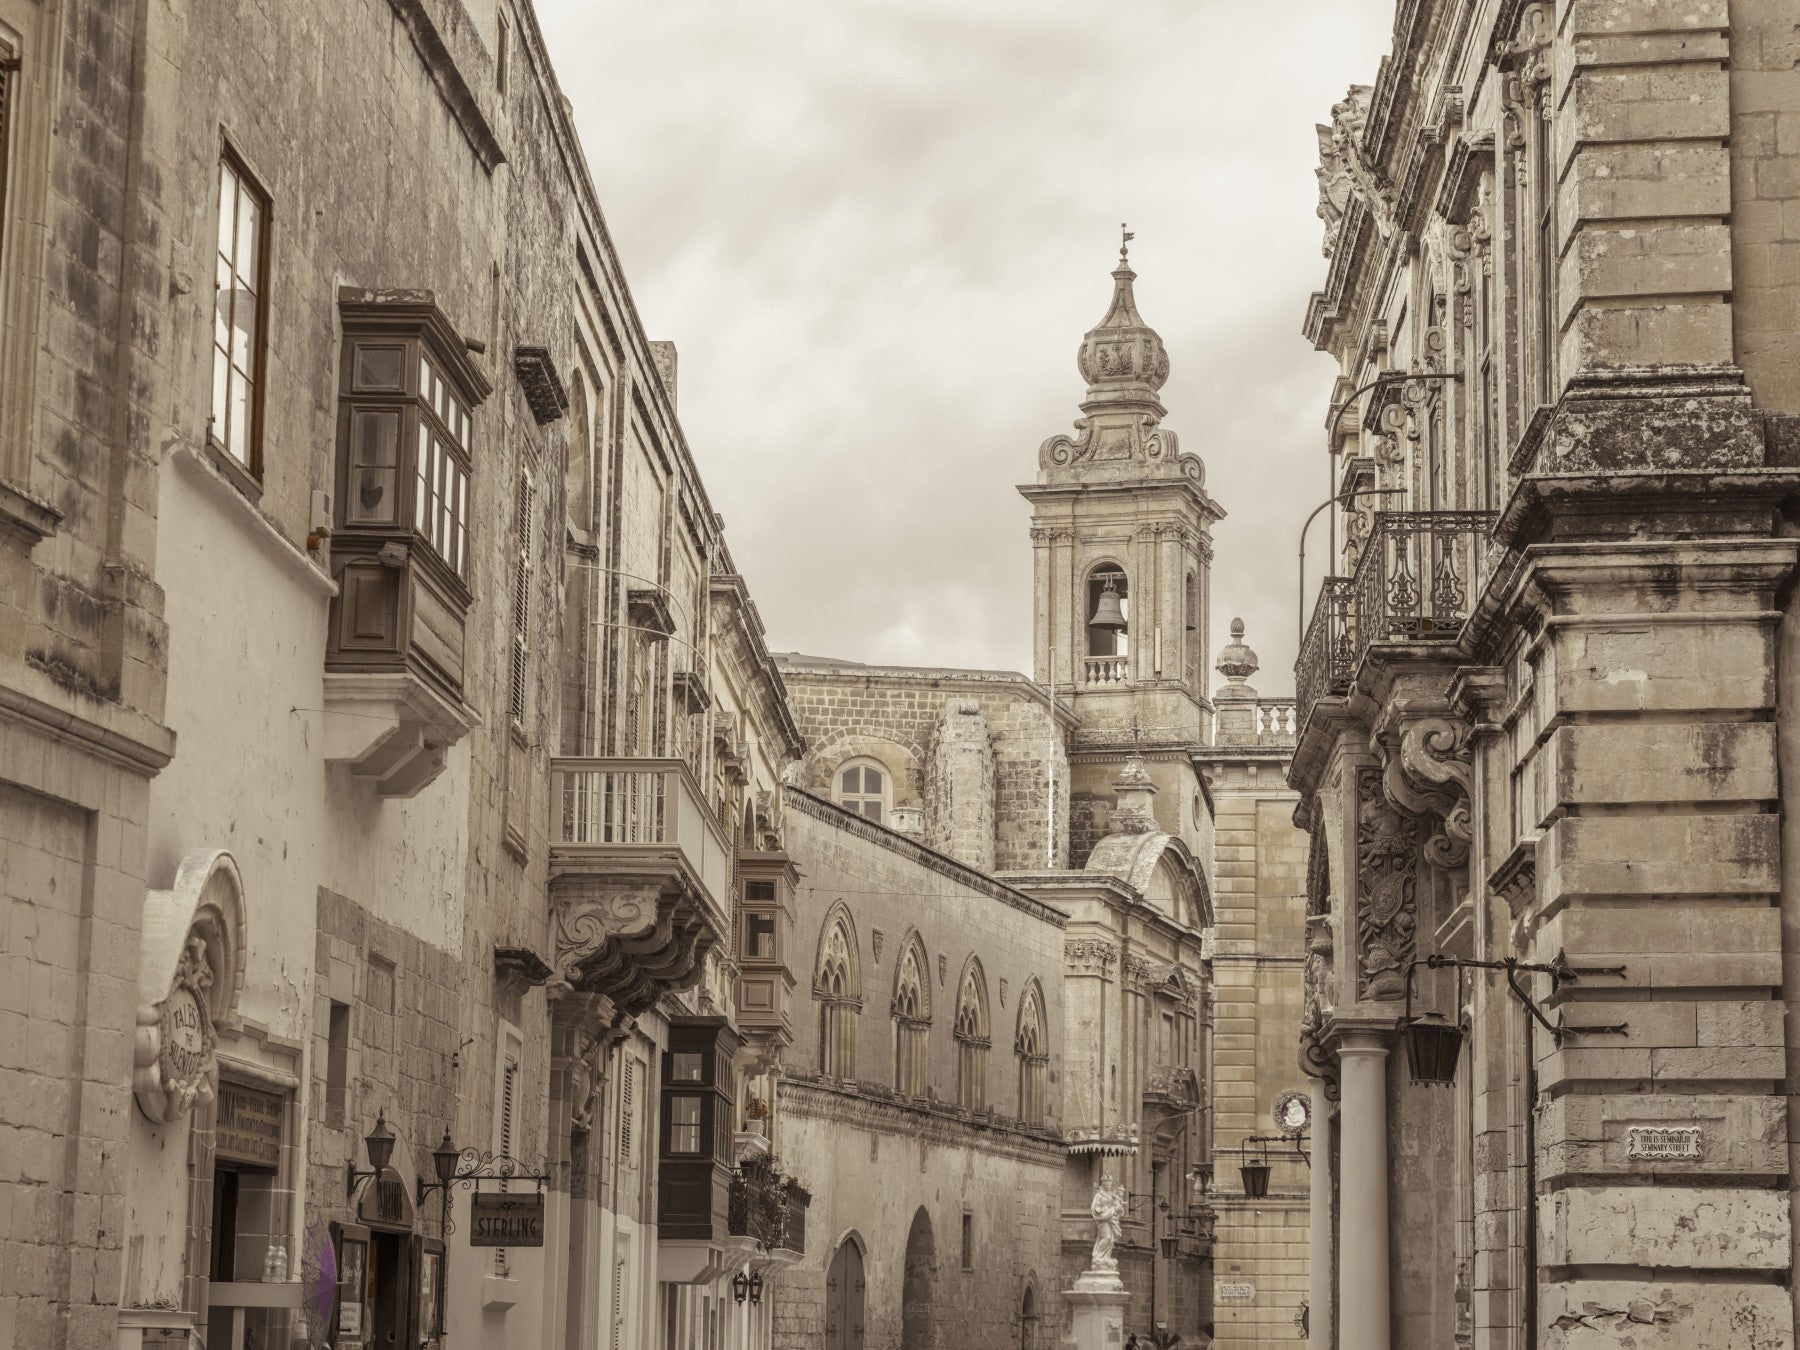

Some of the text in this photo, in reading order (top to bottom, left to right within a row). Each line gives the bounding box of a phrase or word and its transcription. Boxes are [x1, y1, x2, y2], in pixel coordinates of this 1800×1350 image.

[173, 1004, 196, 1029] TALES
[185, 1033, 193, 1047] THE
[478, 1218, 536, 1236] STERLING
